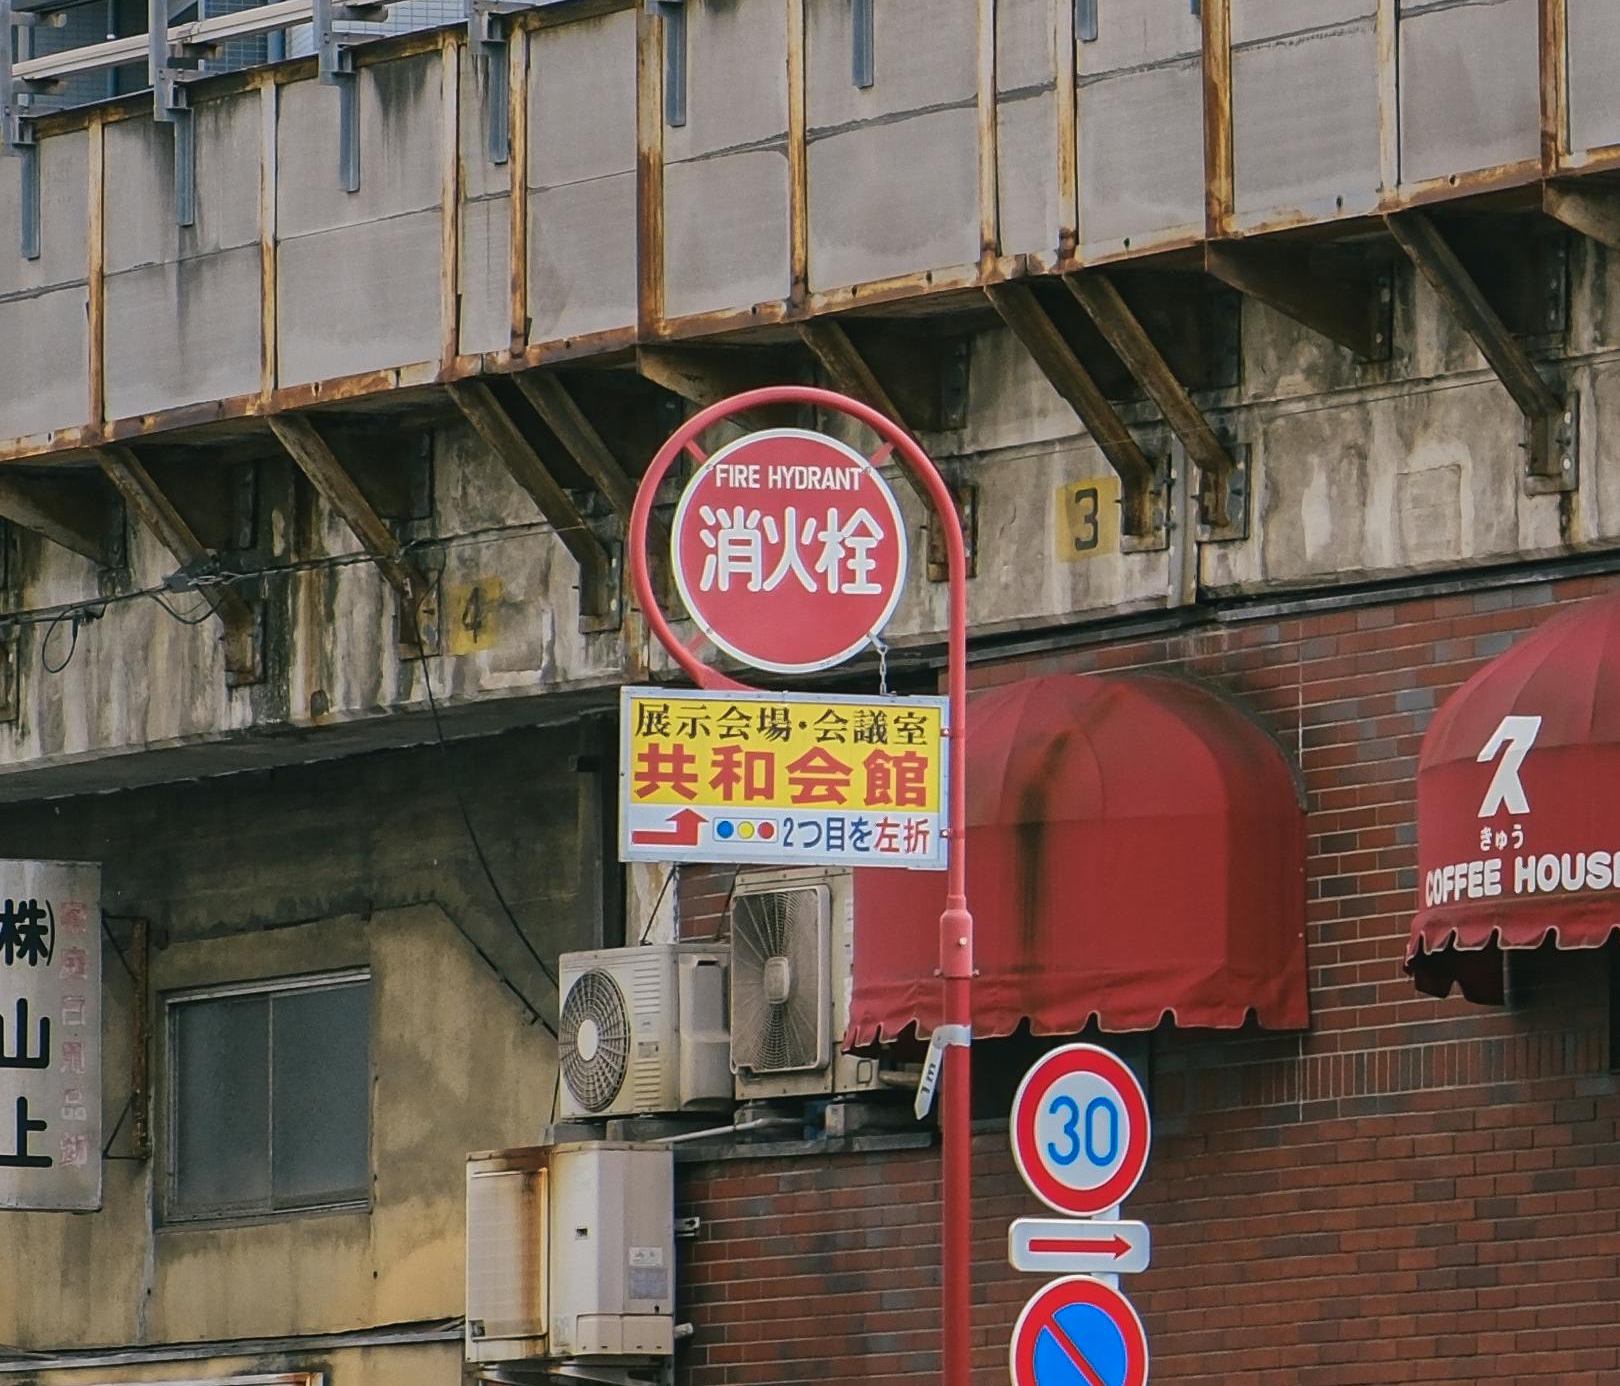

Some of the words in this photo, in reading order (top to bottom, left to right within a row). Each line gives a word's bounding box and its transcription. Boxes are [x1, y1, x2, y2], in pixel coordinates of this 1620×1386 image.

[714, 464, 761, 489] FIRE
[768, 467, 862, 491] HYDRANT
[1074, 488, 1098, 551] 3
[698, 506, 884, 595] 消火栓
[636, 702, 929, 746] 展示会場・会議室
[634, 743, 928, 807] 共和会館
[783, 817, 930, 855] 2つ目を左折
[1479, 824, 1525, 852] きゅう
[1425, 858, 1502, 907] COFFEE
[1047, 1095, 1119, 1167] 30
